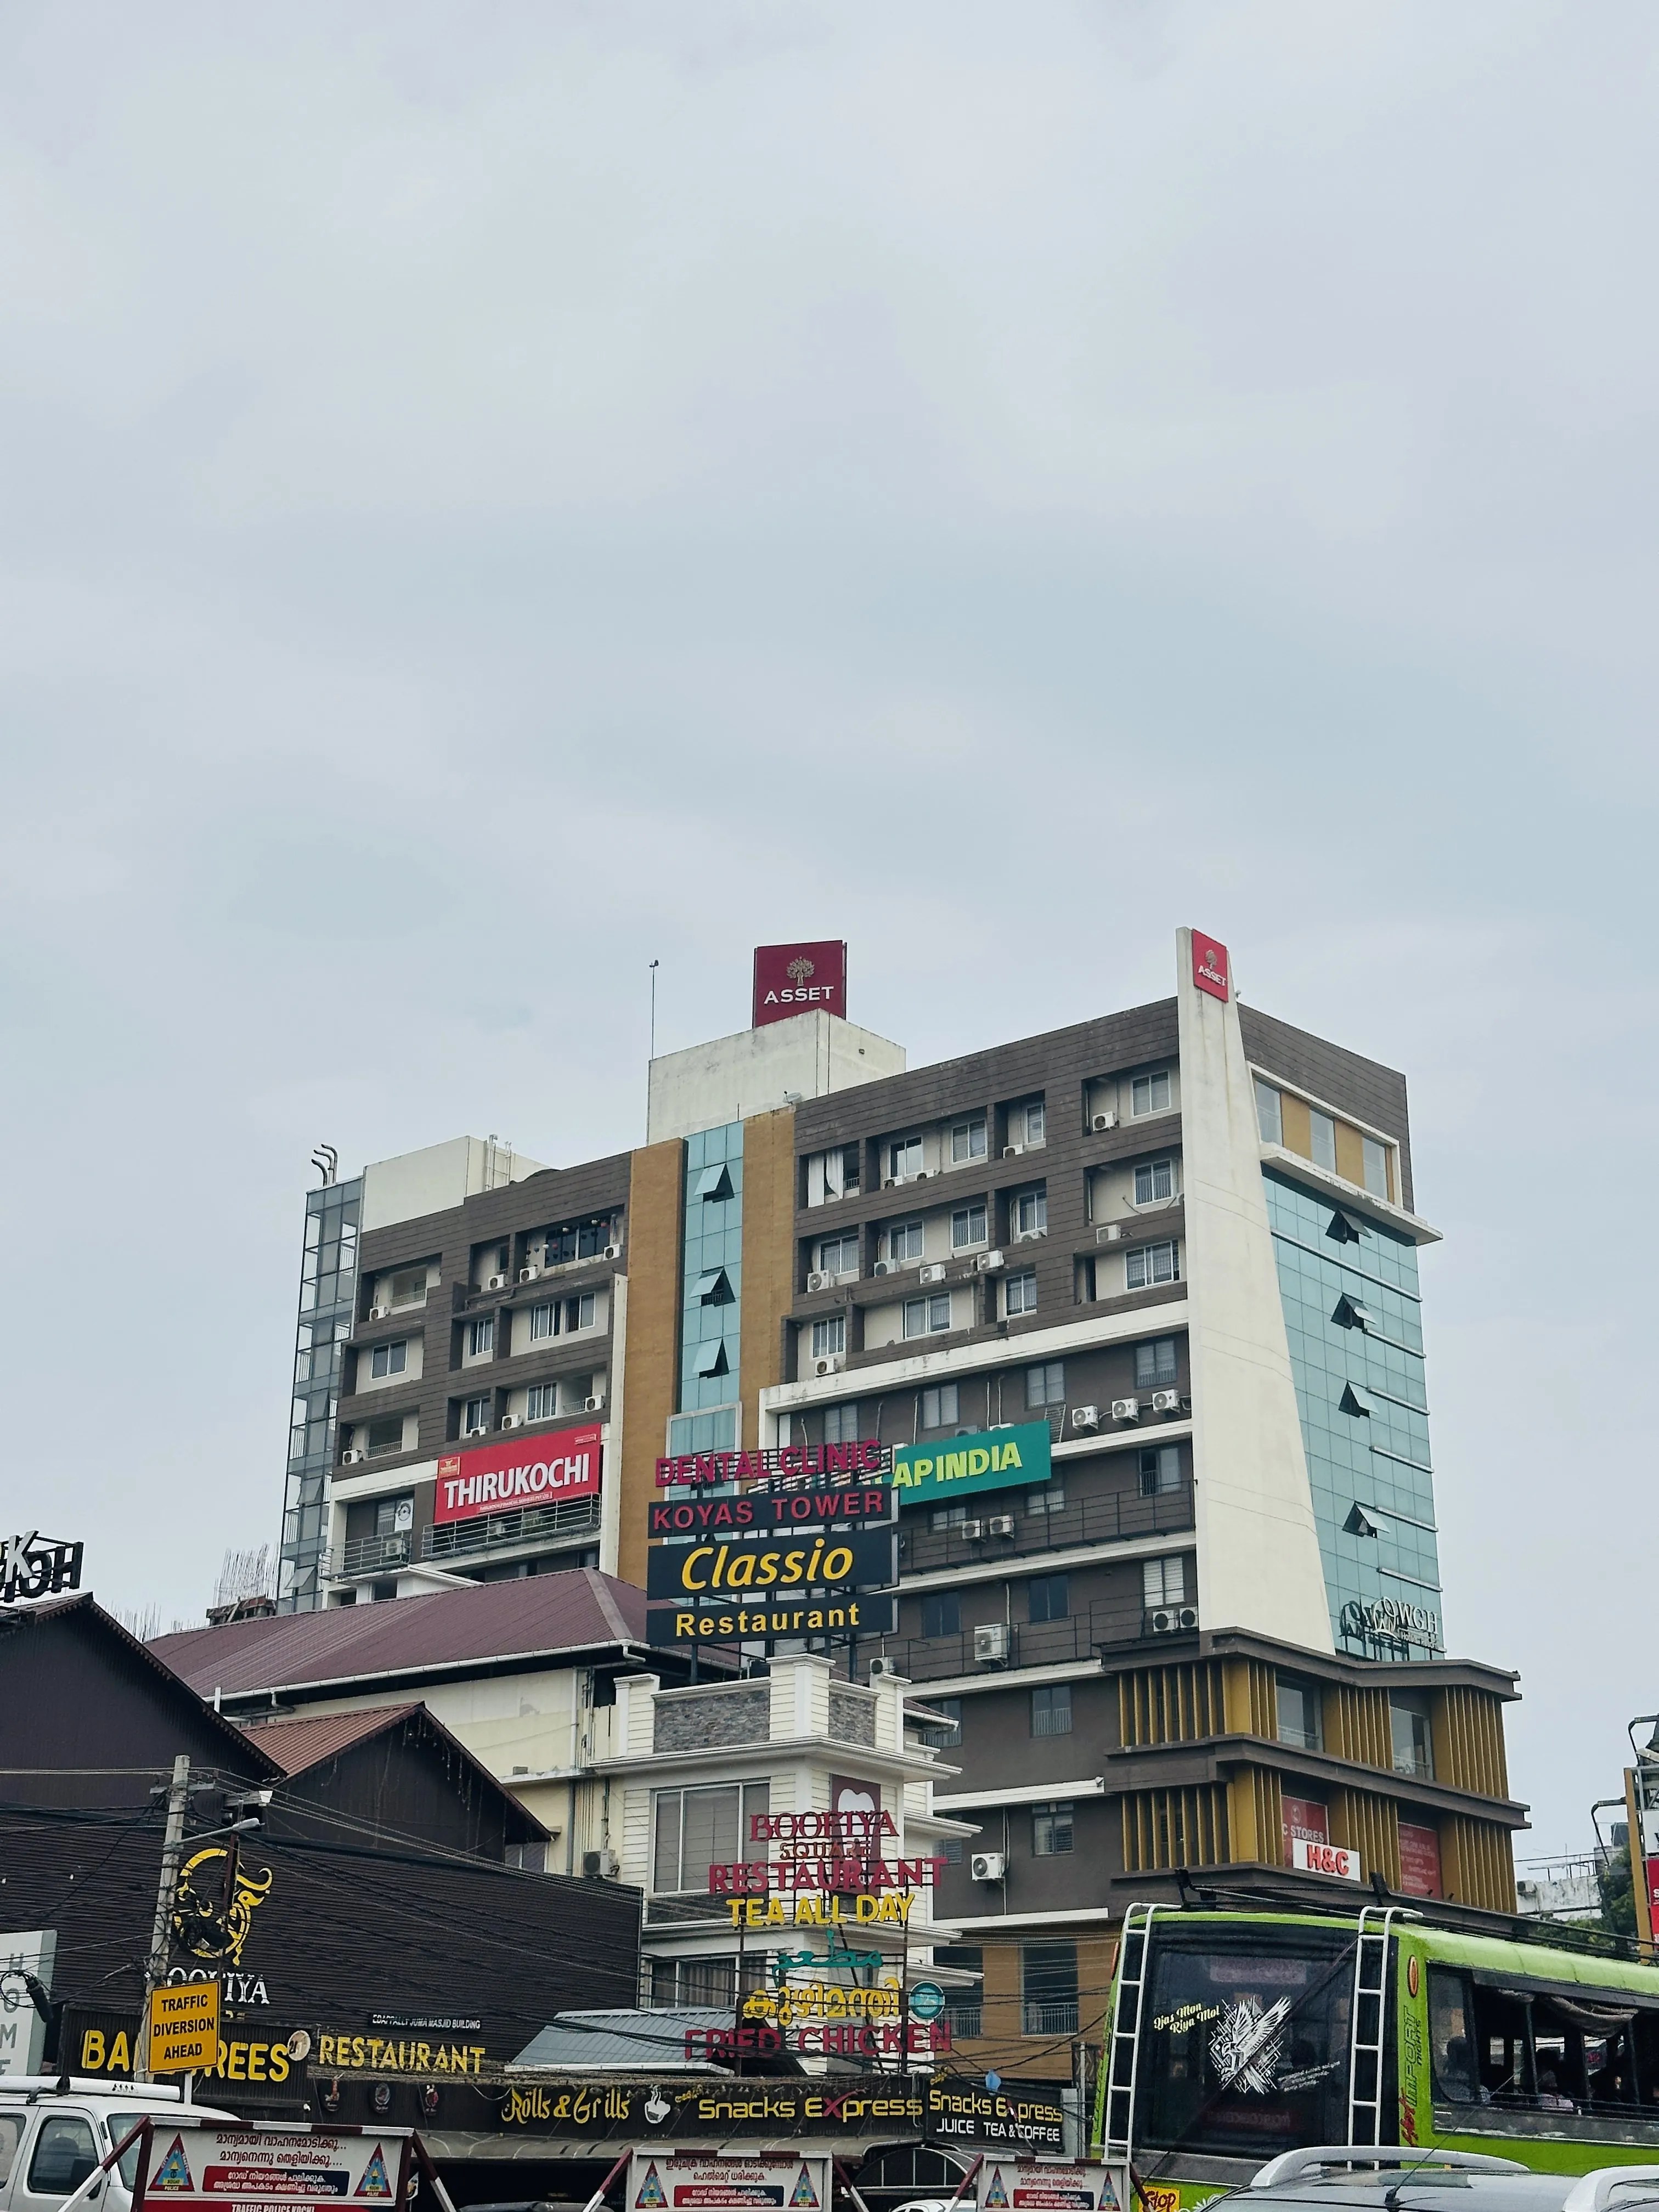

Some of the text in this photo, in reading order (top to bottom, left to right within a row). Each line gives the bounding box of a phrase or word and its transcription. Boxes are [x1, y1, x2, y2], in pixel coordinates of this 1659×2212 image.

[1198, 965, 1226, 986] ASSET
[764, 986, 834, 1005] ASSET
[655, 1438, 881, 1487] DENTAL CLINIC
[444, 1453, 590, 1509] THIRUKOCHI
[653, 1491, 883, 1530] KOYAS TOWER
[681, 1538, 854, 1590] Classio
[676, 1602, 860, 1637] Restaurant
[1290, 1825, 1324, 1843] STORES
[780, 1839, 871, 1860] SQUARE
[1307, 1844, 1349, 1876] H&C
[709, 1856, 949, 1895] RESTAURANT
[726, 1893, 916, 1927] TEA ALL DAY
[161, 1994, 208, 2012] TRAFFIC
[1176, 2003, 1202, 2018] Mon
[1197, 2005, 1220, 2022] Mol
[154, 2017, 215, 2037] DIVERSION
[428, 2018, 451, 2028] MASJID
[452, 2019, 481, 2029] BUILDING
[163, 2043, 202, 2059] AHEAD
[685, 2021, 952, 2060] FRIED CHICKEN
[319, 2034, 486, 2074] RESTAURANT
[554, 2095, 571, 2118] &
[574, 2087, 630, 2124] Grills
[698, 2096, 795, 2119] Snacks
[929, 2090, 991, 2115] Snacks
[936, 2118, 1060, 2142] JUICE TEA & COFFEE
[232, 2204, 262, 2212] TRAFFIC
